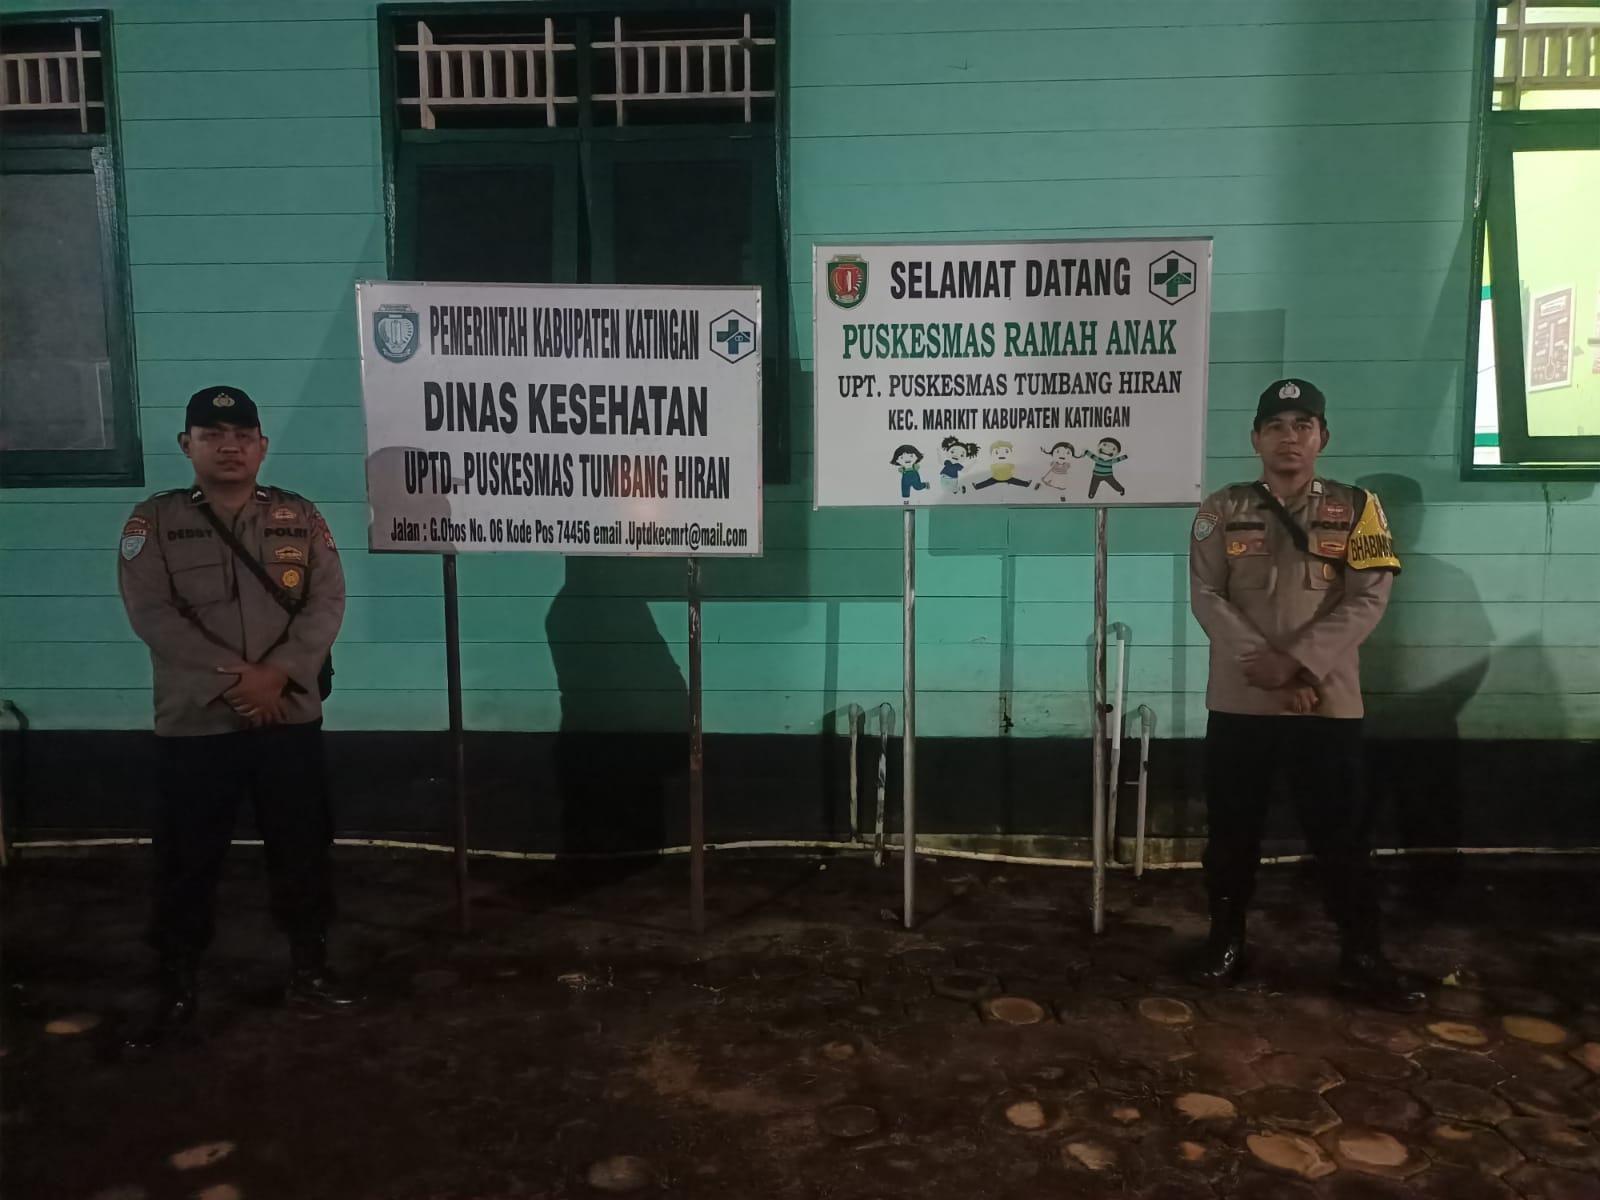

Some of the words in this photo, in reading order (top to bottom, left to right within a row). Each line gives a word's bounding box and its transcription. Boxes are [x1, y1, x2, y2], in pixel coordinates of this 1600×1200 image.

[891, 260, 1016, 299] SELAMAT
[1026, 258, 1130, 297] DATANG
[430, 306, 527, 356] PEMERINTAH
[533, 307, 620, 358] KABUPATEN
[626, 309, 698, 360] KATINGAN
[843, 322, 995, 359] PUSKESMAS
[1004, 321, 1097, 357] RAMAH
[1106, 320, 1176, 355] ANAK
[838, 375, 881, 397] UPT.
[889, 373, 1007, 397] PUSKESMAS
[1014, 372, 1112, 395] TUMBANG
[1119, 371, 1182, 394] HIRAN
[424, 382, 518, 434] DINAS
[529, 383, 707, 436] KESEHATAN
[889, 409, 917, 430] KEC.
[923, 409, 978, 430] MARIKIT
[983, 407, 1059, 429] KABUPATEN
[1065, 406, 1130, 428] KATINGAN
[405, 451, 457, 494] UPTD.
[464, 452, 573, 497] PUSKESMAS
[579, 454, 668, 498] TUMBANG
[675, 456, 729, 499] HIRAN
[391, 518, 419, 541] Jalan
[430, 518, 466, 541] G.Obos
[470, 518, 486, 542] No.
[490, 519, 503, 542] 06
[507, 519, 531, 543] Kode
[535, 520, 553, 543] Pos
[557, 520, 590, 544] 74456
[594, 521, 621, 544] email
